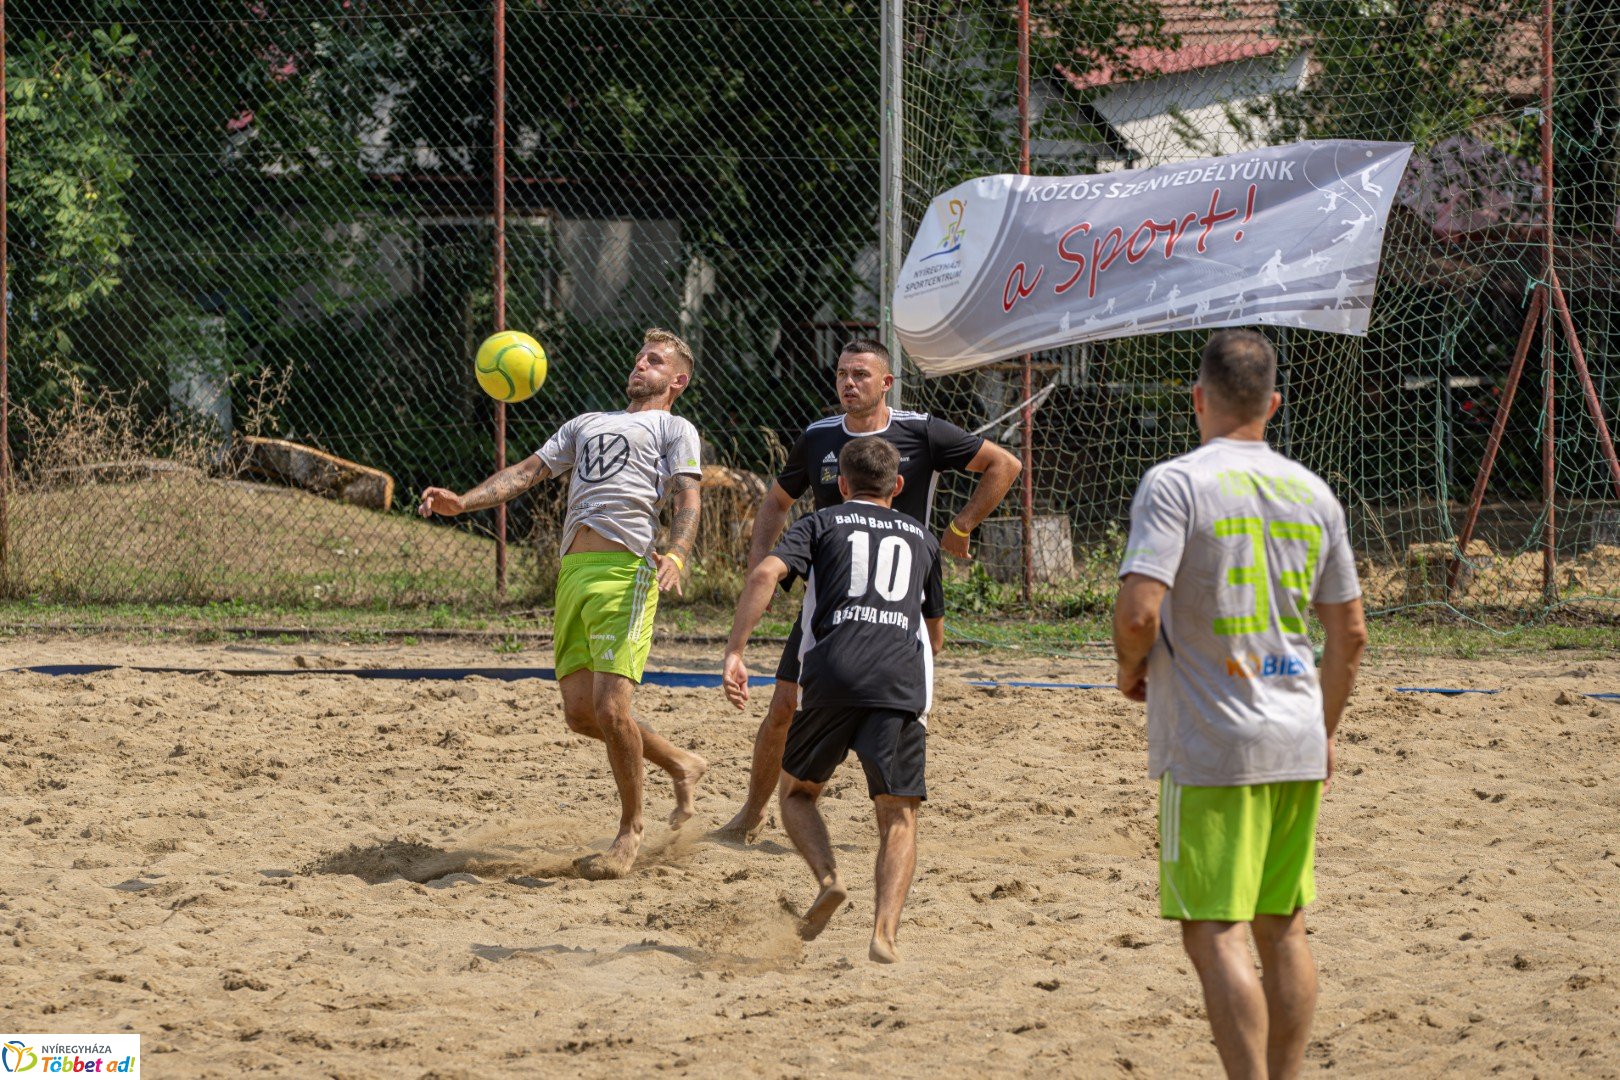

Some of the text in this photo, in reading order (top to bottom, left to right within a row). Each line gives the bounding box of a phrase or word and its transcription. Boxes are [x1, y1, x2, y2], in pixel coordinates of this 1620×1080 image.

[1025, 158, 1297, 203] KÖZÖS SZENVEDÉLYÜNK
[1002, 183, 1257, 314] a Sport!
[835, 512, 925, 540] Balla Bau Team
[847, 529, 913, 602] 10
